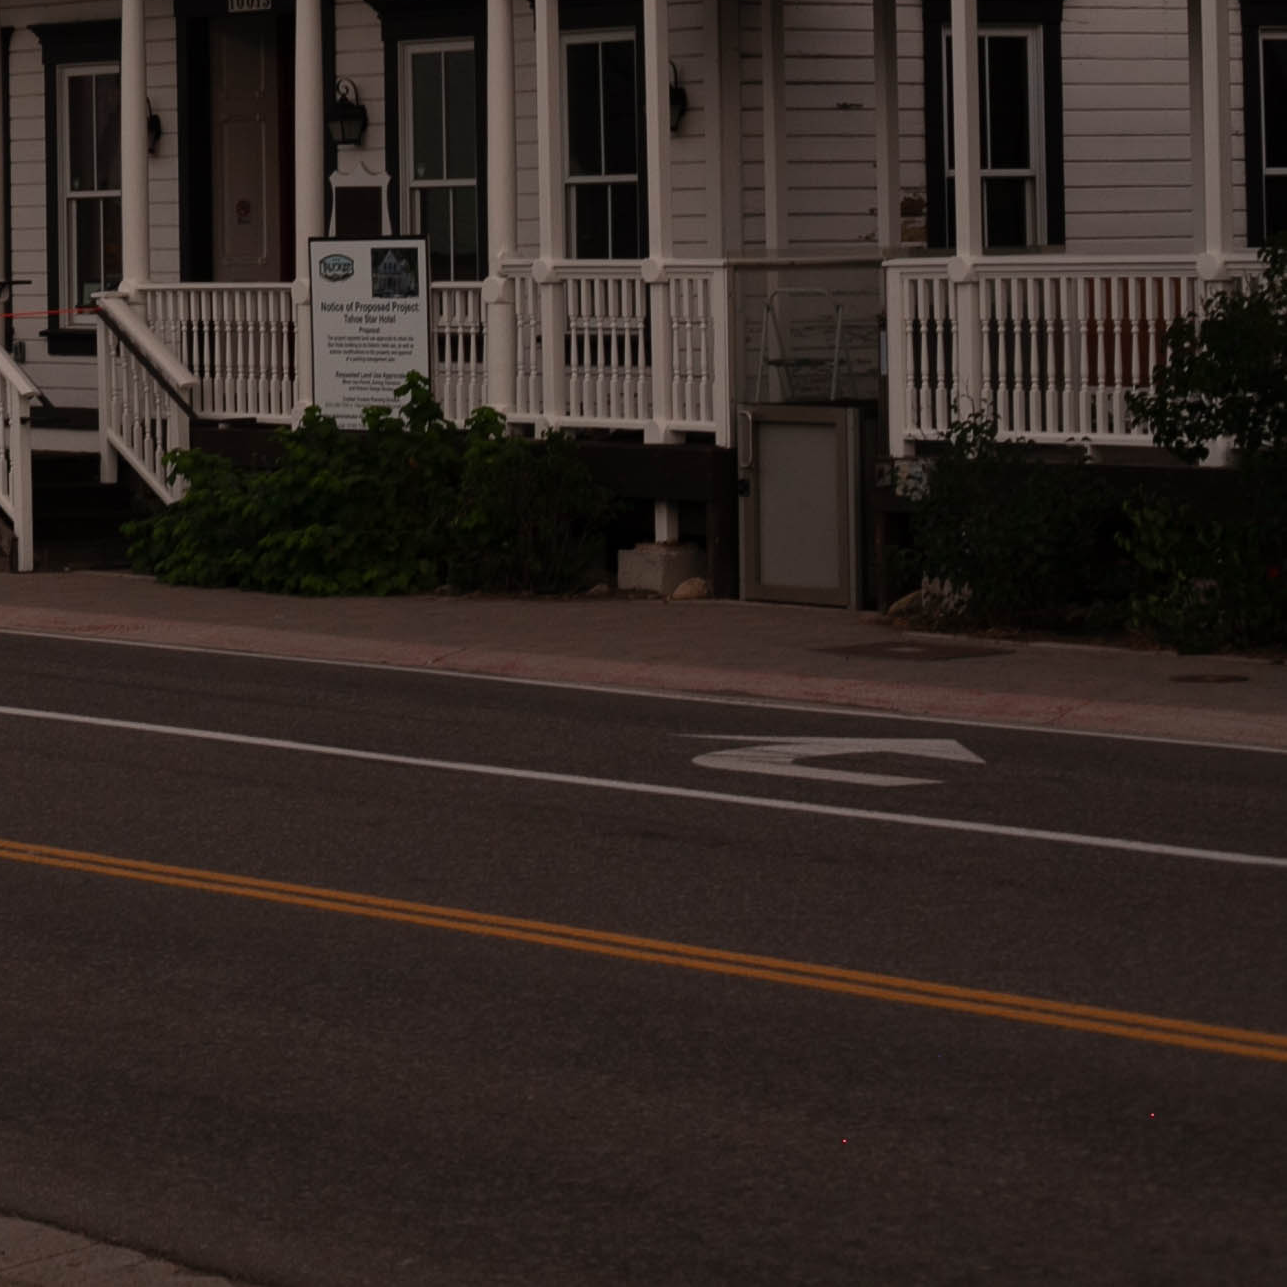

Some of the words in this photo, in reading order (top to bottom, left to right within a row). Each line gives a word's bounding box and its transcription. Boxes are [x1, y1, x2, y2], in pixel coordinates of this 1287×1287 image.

[320, 301, 344, 313] Notice
[346, 301, 354, 313] of
[355, 301, 391, 314] Proposed
[392, 301, 419, 314] Project
